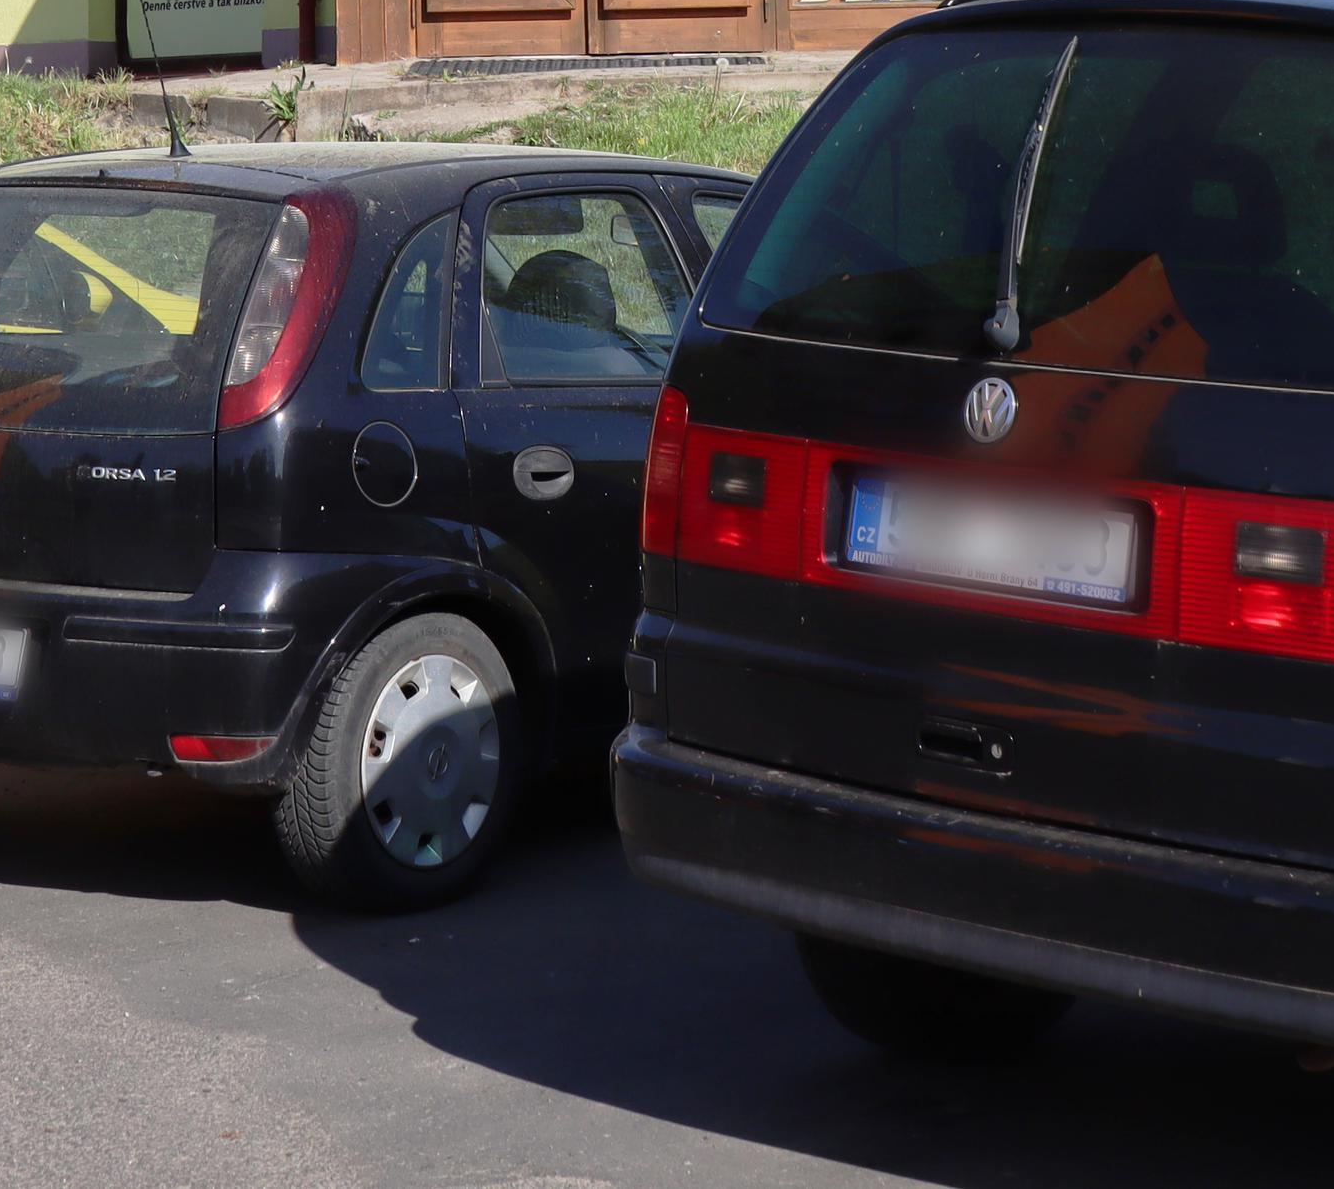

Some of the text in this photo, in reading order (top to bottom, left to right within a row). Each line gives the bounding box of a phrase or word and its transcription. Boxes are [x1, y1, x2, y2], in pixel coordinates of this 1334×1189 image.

[143, 1, 172, 12] Denně
[208, 0, 214, 8] a
[857, 525, 876, 544] CZ
[1027, 576, 1039, 587] 64
[1057, 581, 1121, 601] 491-520082
